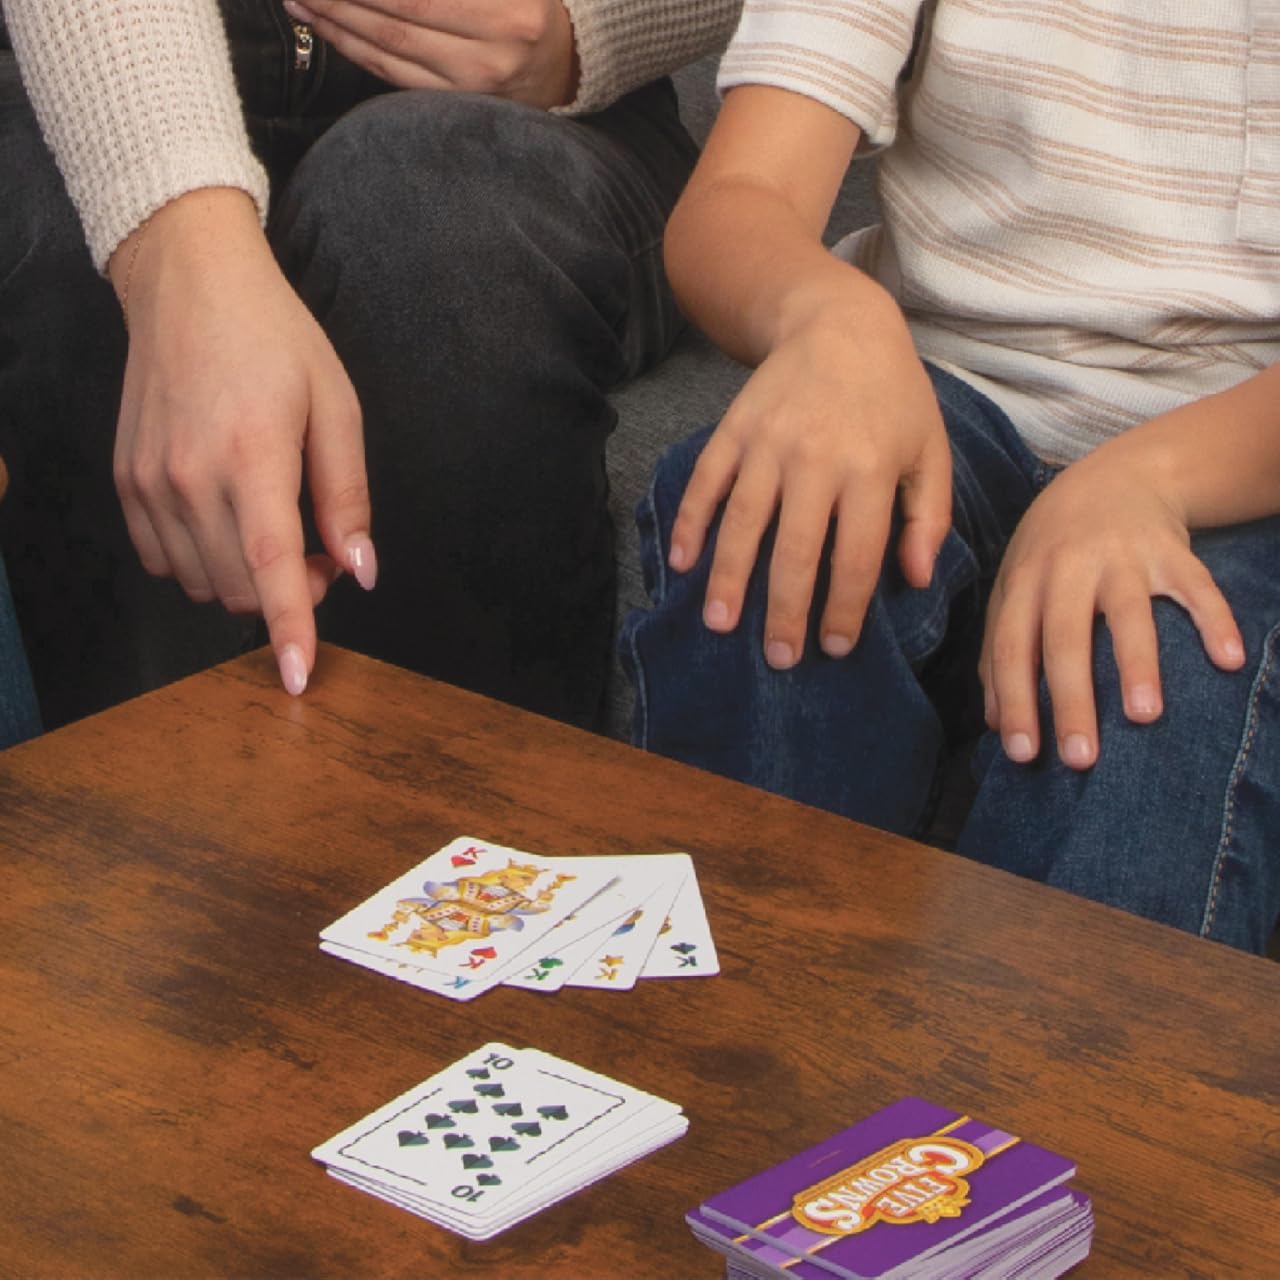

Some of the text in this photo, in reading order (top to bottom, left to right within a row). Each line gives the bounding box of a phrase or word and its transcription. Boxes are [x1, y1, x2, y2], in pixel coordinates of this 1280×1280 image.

[482, 1052, 515, 1071] 10
[450, 1184, 486, 1203] 10
[803, 1144, 969, 1230] CROWNS
[876, 1176, 949, 1218] FIVE
